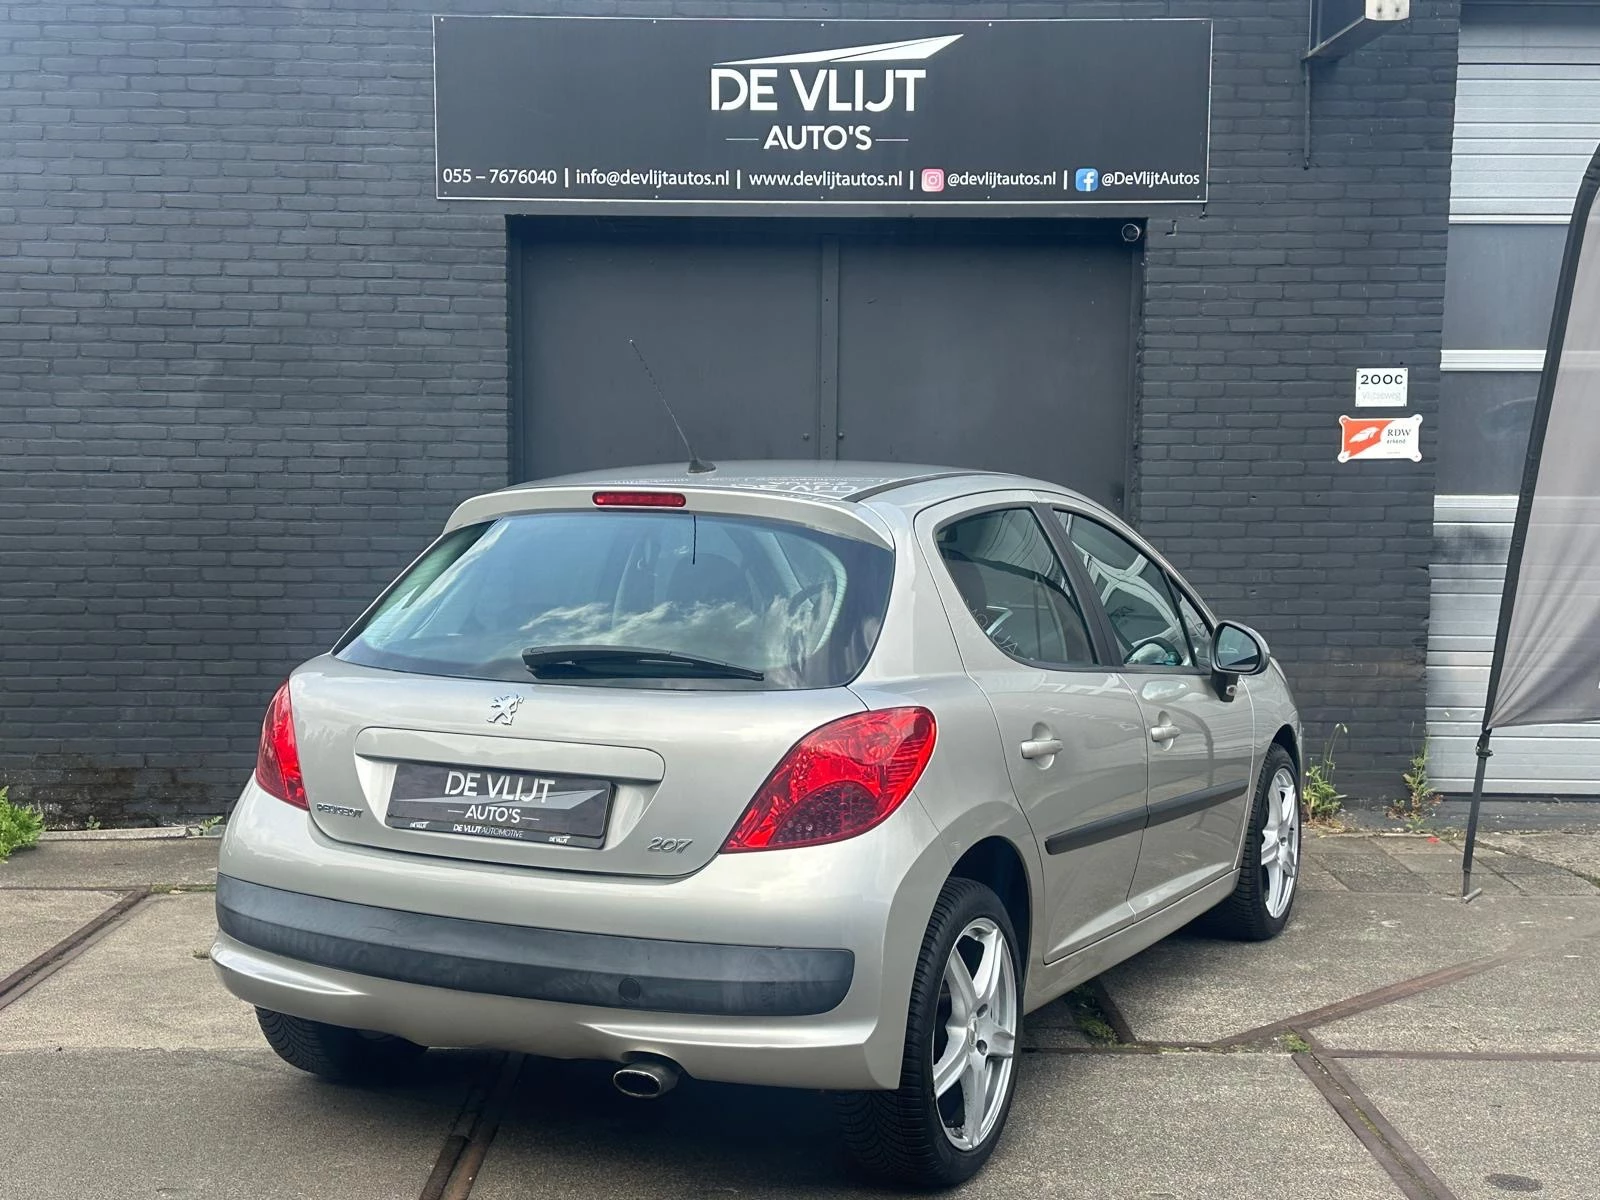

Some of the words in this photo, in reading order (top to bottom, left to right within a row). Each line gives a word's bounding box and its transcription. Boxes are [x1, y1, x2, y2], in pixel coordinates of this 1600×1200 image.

[711, 68, 778, 111] DE
[789, 69, 927, 112] VLIJT
[763, 125, 873, 151] AUTO'S
[443, 168, 472, 183] 055
[489, 169, 557, 184] 7676040
[575, 169, 730, 188] info@devlijtautos.nl
[749, 171, 903, 190] www.devlijtautos.nl
[947, 171, 1056, 189] @devlijtautos.nl
[1101, 171, 1200, 188] @DeVlijtAutos
[1360, 374, 1404, 385] 200C
[1387, 428, 1412, 437] RDW
[444, 770, 481, 797] DE
[486, 773, 556, 803] VLIJT
[464, 804, 521, 824] AUTO'S
[647, 836, 693, 854] 207
